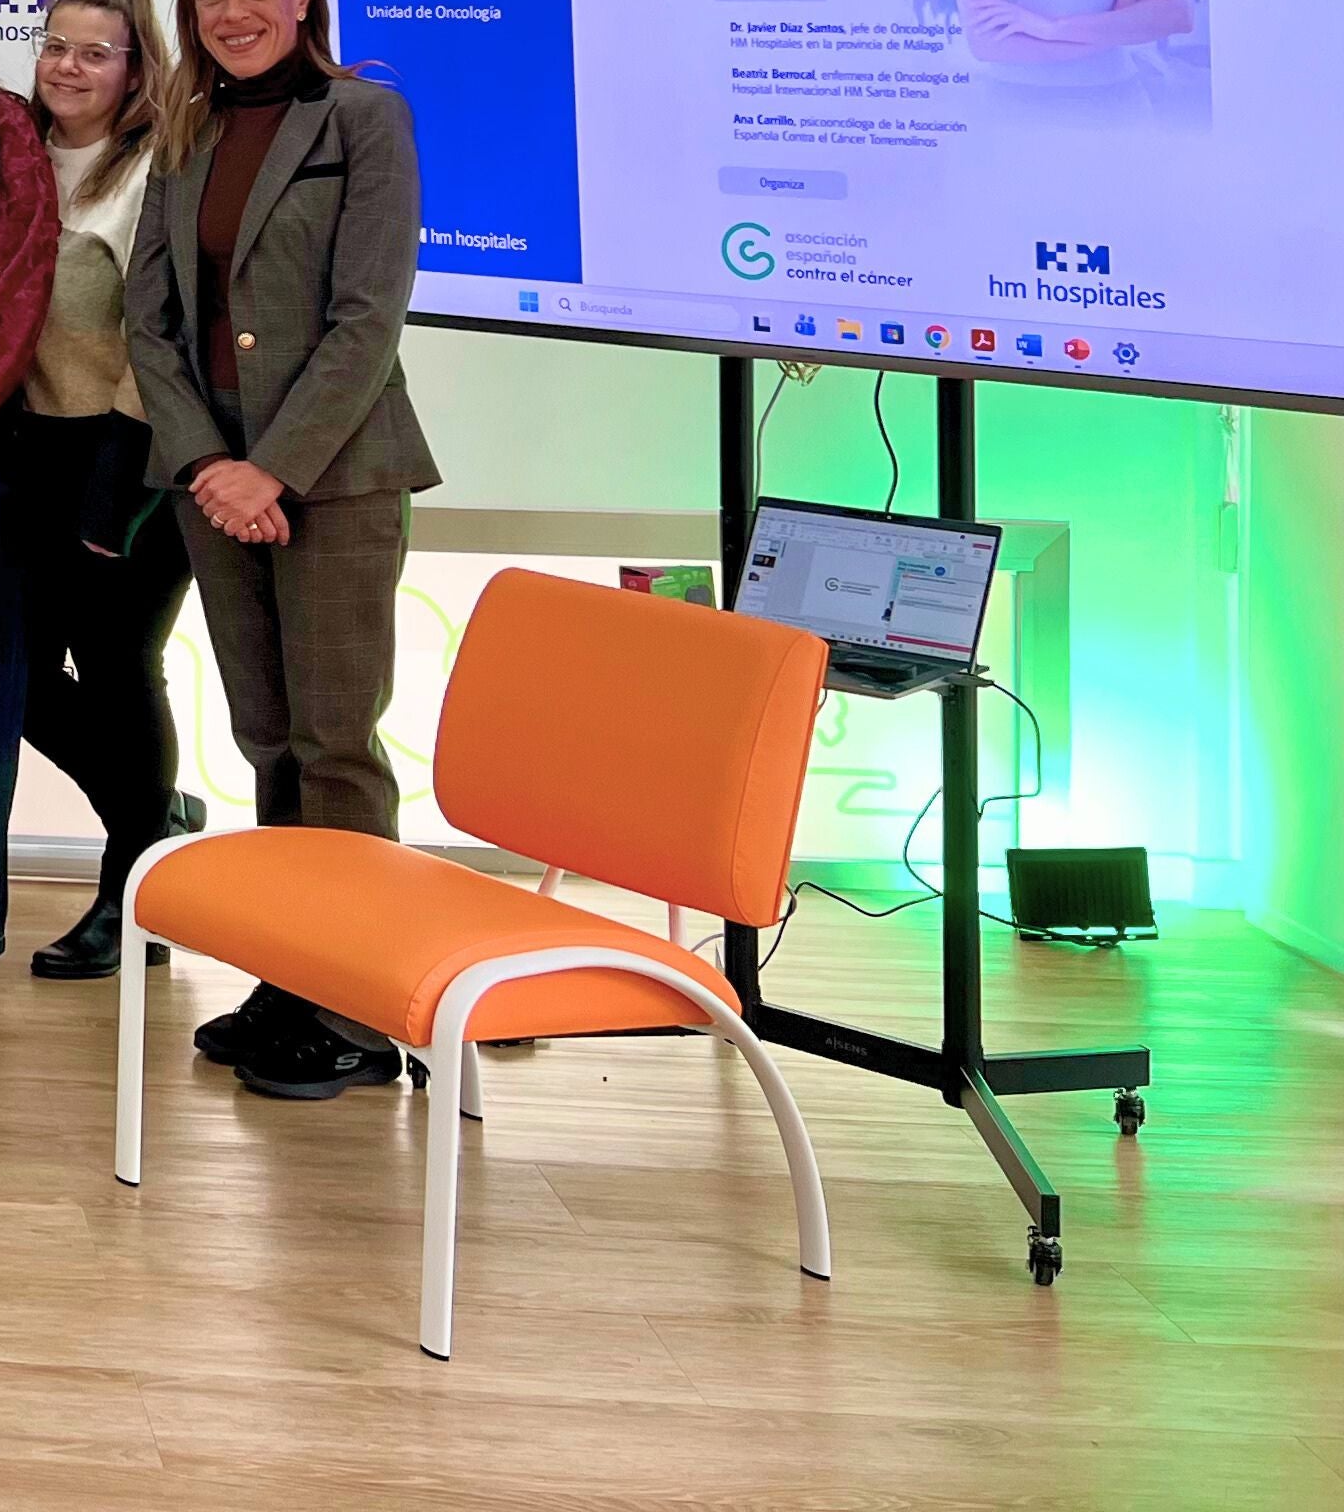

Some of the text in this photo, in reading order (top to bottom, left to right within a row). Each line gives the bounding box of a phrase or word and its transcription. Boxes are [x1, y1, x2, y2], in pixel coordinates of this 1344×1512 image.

[366, 5, 502, 22] Unidad de Oncología
[747, 22, 777, 34] Javier
[873, 23, 888, 34] de
[948, 23, 962, 35] de
[730, 37, 748, 48] HM
[751, 38, 803, 51] Hospitales
[806, 40, 819, 49] en
[822, 38, 832, 49] la
[836, 39, 883, 52] provincia
[886, 39, 900, 50] de
[732, 68, 768, 79] Beatriz
[877, 70, 891, 82] de
[952, 71, 970, 83] del
[732, 83, 930, 99] Hospital Internacional HM Santa Elena
[733, 114, 754, 126] Ana
[878, 118, 892, 130] de
[895, 119, 905, 130] la
[734, 129, 779, 142] Española
[782, 131, 815, 142] Contra
[818, 131, 828, 143] el
[759, 176, 805, 190] Organiza
[430, 228, 453, 245] hm
[455, 229, 527, 252] hospitales
[785, 231, 868, 249] asociación
[786, 248, 857, 267] española
[786, 267, 913, 287] contra el cáncer
[989, 274, 1166, 310] hm hospitales
